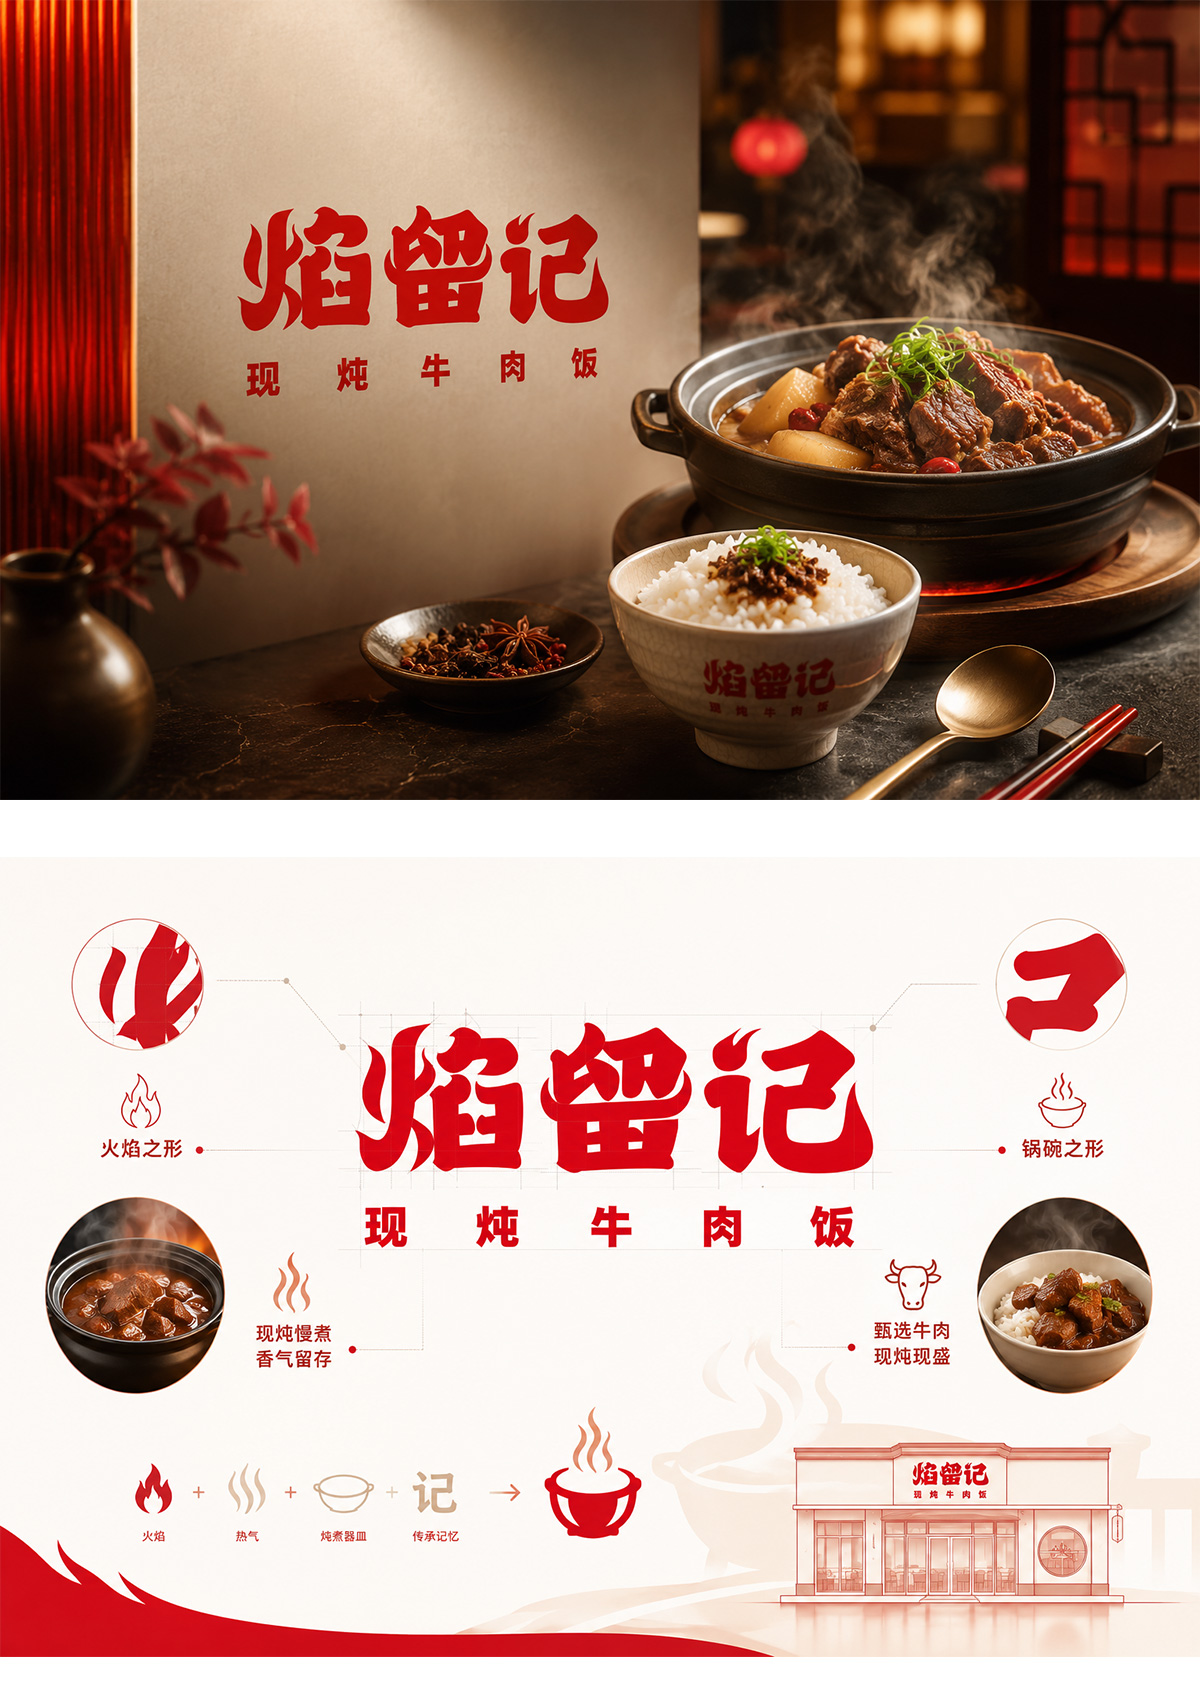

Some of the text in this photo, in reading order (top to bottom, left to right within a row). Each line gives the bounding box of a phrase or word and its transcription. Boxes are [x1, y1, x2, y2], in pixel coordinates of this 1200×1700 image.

[238, 206, 608, 331] 焰留记
[246, 348, 597, 397] 现炖牛肉饭
[704, 659, 839, 699] 焰留记
[708, 701, 829, 717] 现炖牛肉饭
[356, 1023, 873, 1173] 焰留记
[101, 1139, 182, 1158] 火焰之形
[1022, 1139, 1103, 1158] 锅碗之形
[365, 1206, 854, 1247] 现炖牛肉饭
[256, 1324, 331, 1342] 现炖慢煮
[874, 1321, 949, 1339] 甄选牛肉
[257, 1350, 331, 1368] 香气留存
[874, 1347, 950, 1365] 现炖现盛
[913, 1462, 989, 1485] 焰留记
[413, 1472, 457, 1513] 记
[914, 1490, 986, 1498] 现炖牛肉饭
[143, 1531, 165, 1541] 火焰
[236, 1531, 259, 1542] 热气
[321, 1531, 366, 1542] 炖煮器皿
[413, 1531, 459, 1542] 传承记忆
